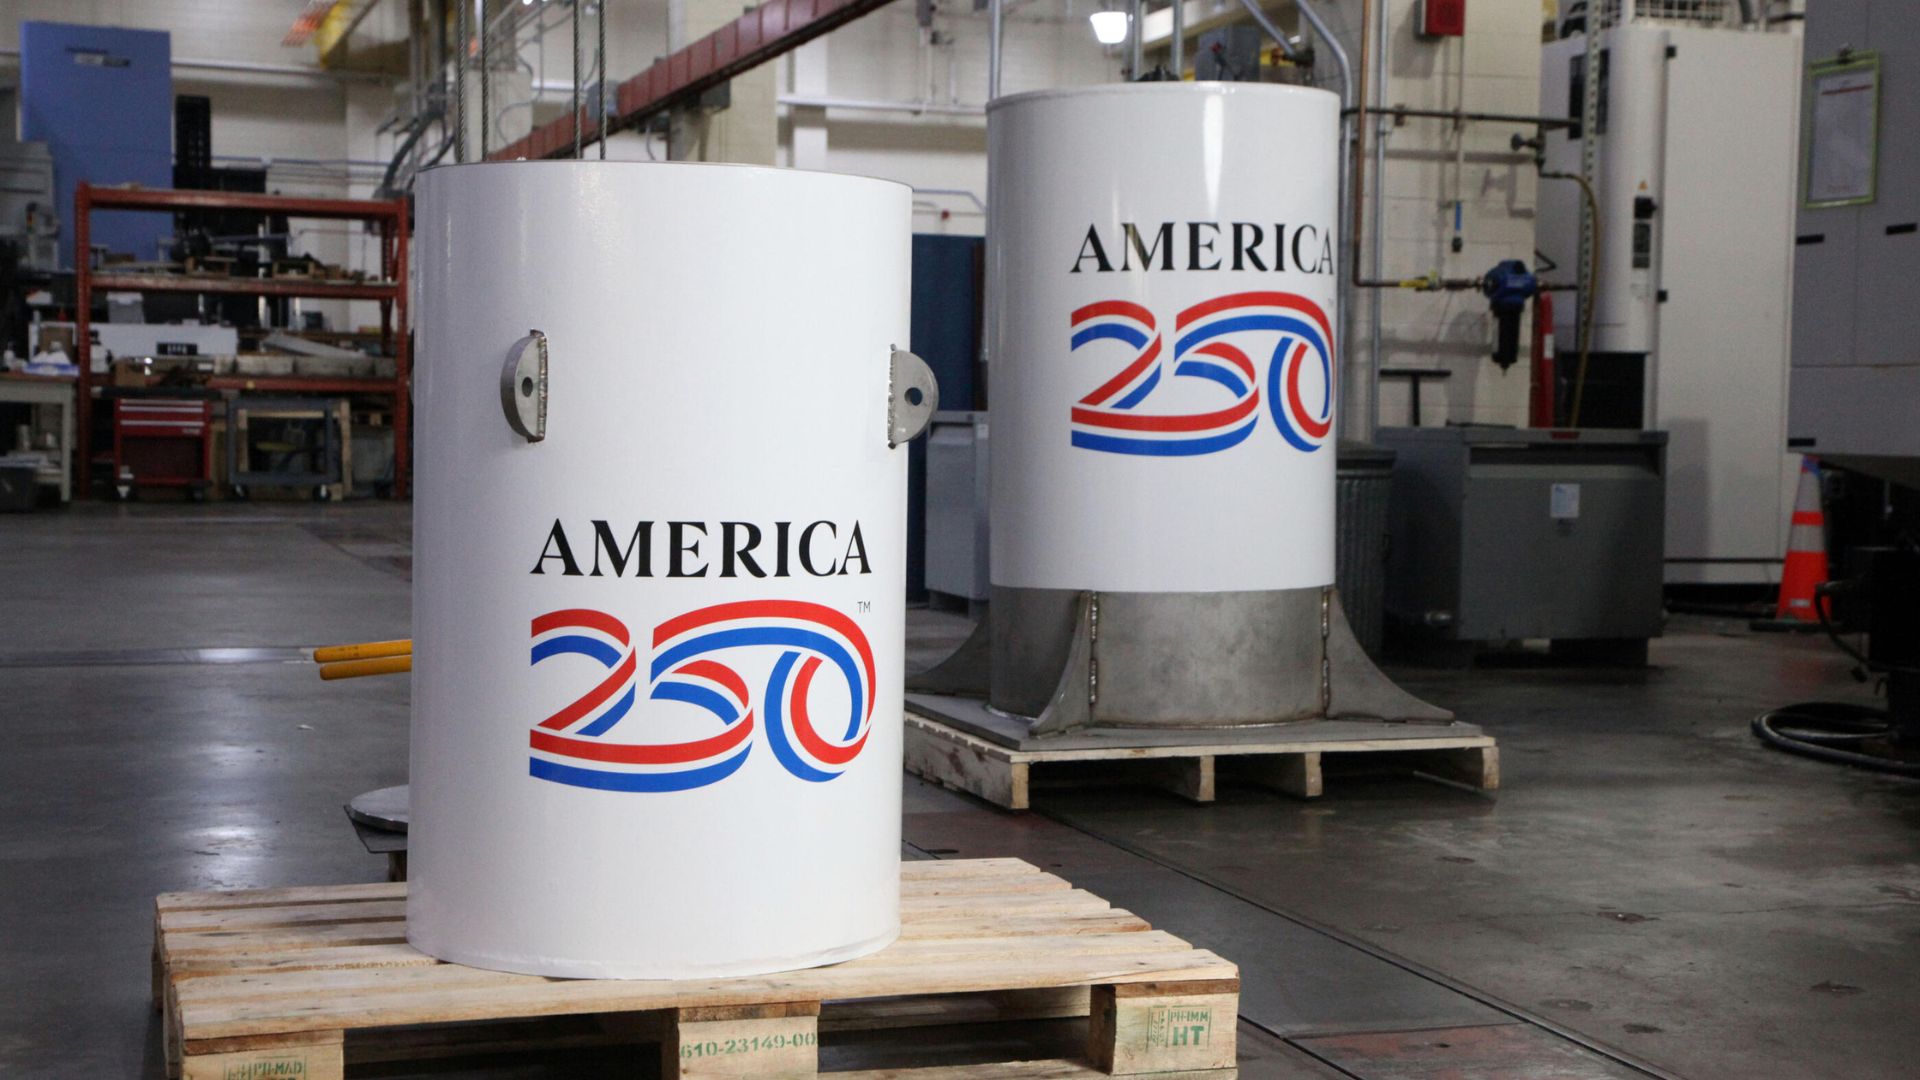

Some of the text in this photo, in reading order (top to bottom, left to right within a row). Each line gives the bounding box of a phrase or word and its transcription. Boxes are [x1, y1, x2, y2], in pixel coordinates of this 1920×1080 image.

[1069, 222, 1334, 275] AMERICA
[1071, 291, 1335, 457] 250
[529, 518, 872, 578] AMERICA
[857, 601, 871, 613] TM
[529, 599, 876, 793] 250
[680, 1033, 816, 1058] 610-23149-00
[1172, 1026, 1204, 1046] HT
